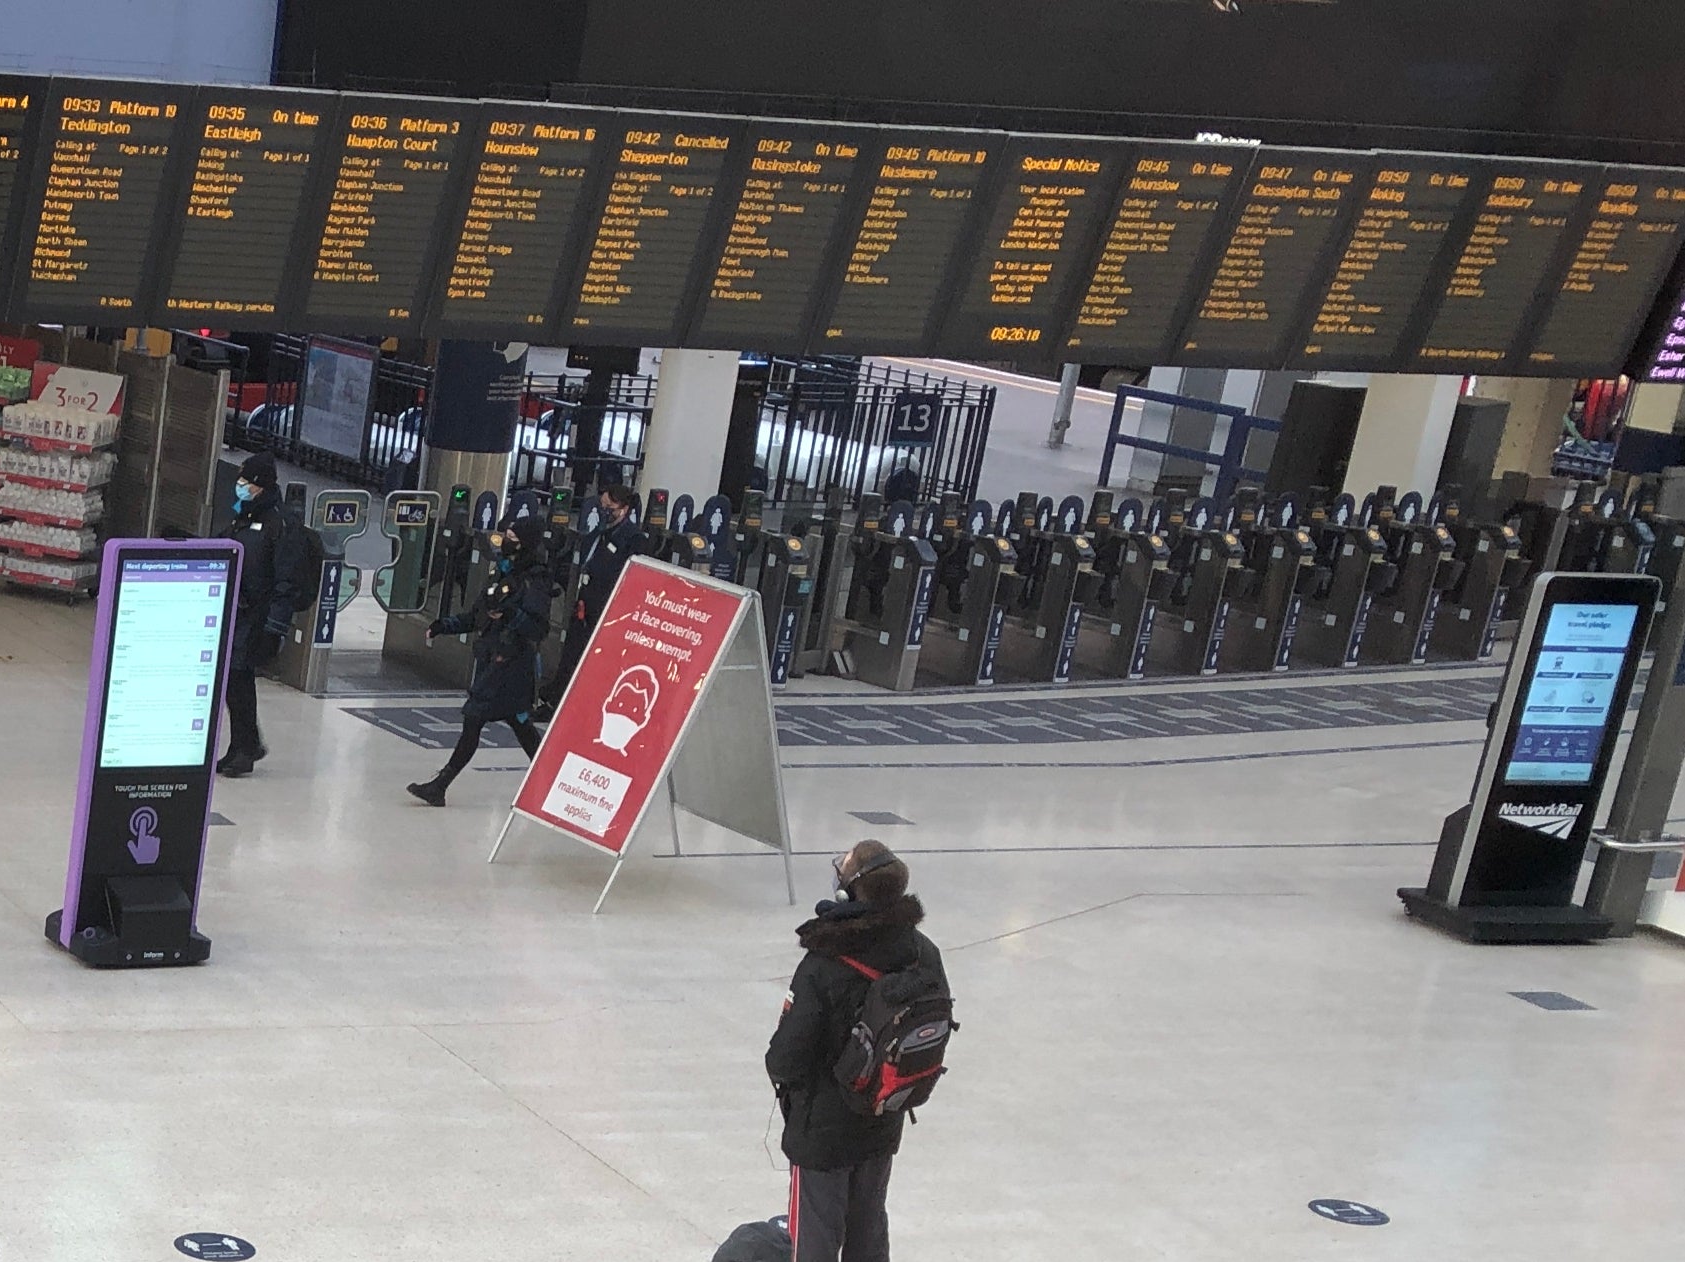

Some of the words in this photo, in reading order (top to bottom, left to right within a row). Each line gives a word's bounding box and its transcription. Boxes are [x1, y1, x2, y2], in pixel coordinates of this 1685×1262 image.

[21, 95, 28, 108] 4
[63, 98, 100, 112] 09:33
[110, 101, 159, 116] Platform
[165, 105, 177, 117] 19
[209, 106, 246, 120] 09:35
[273, 110, 288, 123] On
[294, 112, 319, 125] time
[61, 117, 130, 134] Teddington
[205, 125, 261, 142] Eastleigh
[400, 118, 447, 133] Platform
[451, 122, 460, 134] 3
[490, 122, 525, 136] 09:37
[533, 125, 580, 140] Platform
[347, 134, 398, 149] Hampton
[403, 138, 437, 151] Court
[485, 141, 539, 156] Hounslow
[626, 131, 660, 145] 09:42
[674, 134, 729, 149] Cancelled
[758, 140, 792, 153] 09:42
[816, 143, 830, 156] On
[835, 145, 858, 157] time
[620, 149, 688, 165] Shepperton
[887, 147, 921, 160] 09:45
[927, 149, 971, 162] Platform
[752, 158, 821, 173] Basingstoke
[880, 165, 937, 179] Haslemere
[1022, 157, 1062, 171] Special
[1064, 159, 1100, 172] Notice
[56, 387, 66, 407] 3
[68, 395, 86, 405] FOR
[87, 392, 98, 412] 2
[898, 404, 931, 431] 13
[142, 563, 170, 571] departing
[645, 591, 665, 606] You
[661, 598, 690, 616] must
[687, 608, 712, 623] wear
[632, 611, 639, 621] a
[640, 611, 660, 628] face
[661, 621, 702, 645] covering,
[625, 630, 655, 648] unless
[578, 768, 610, 790] £6,400
[558, 775, 602, 804] maximum
[598, 797, 613, 812] fine
[564, 804, 592, 821] applies
[1499, 803, 1583, 815] NetworkRail
